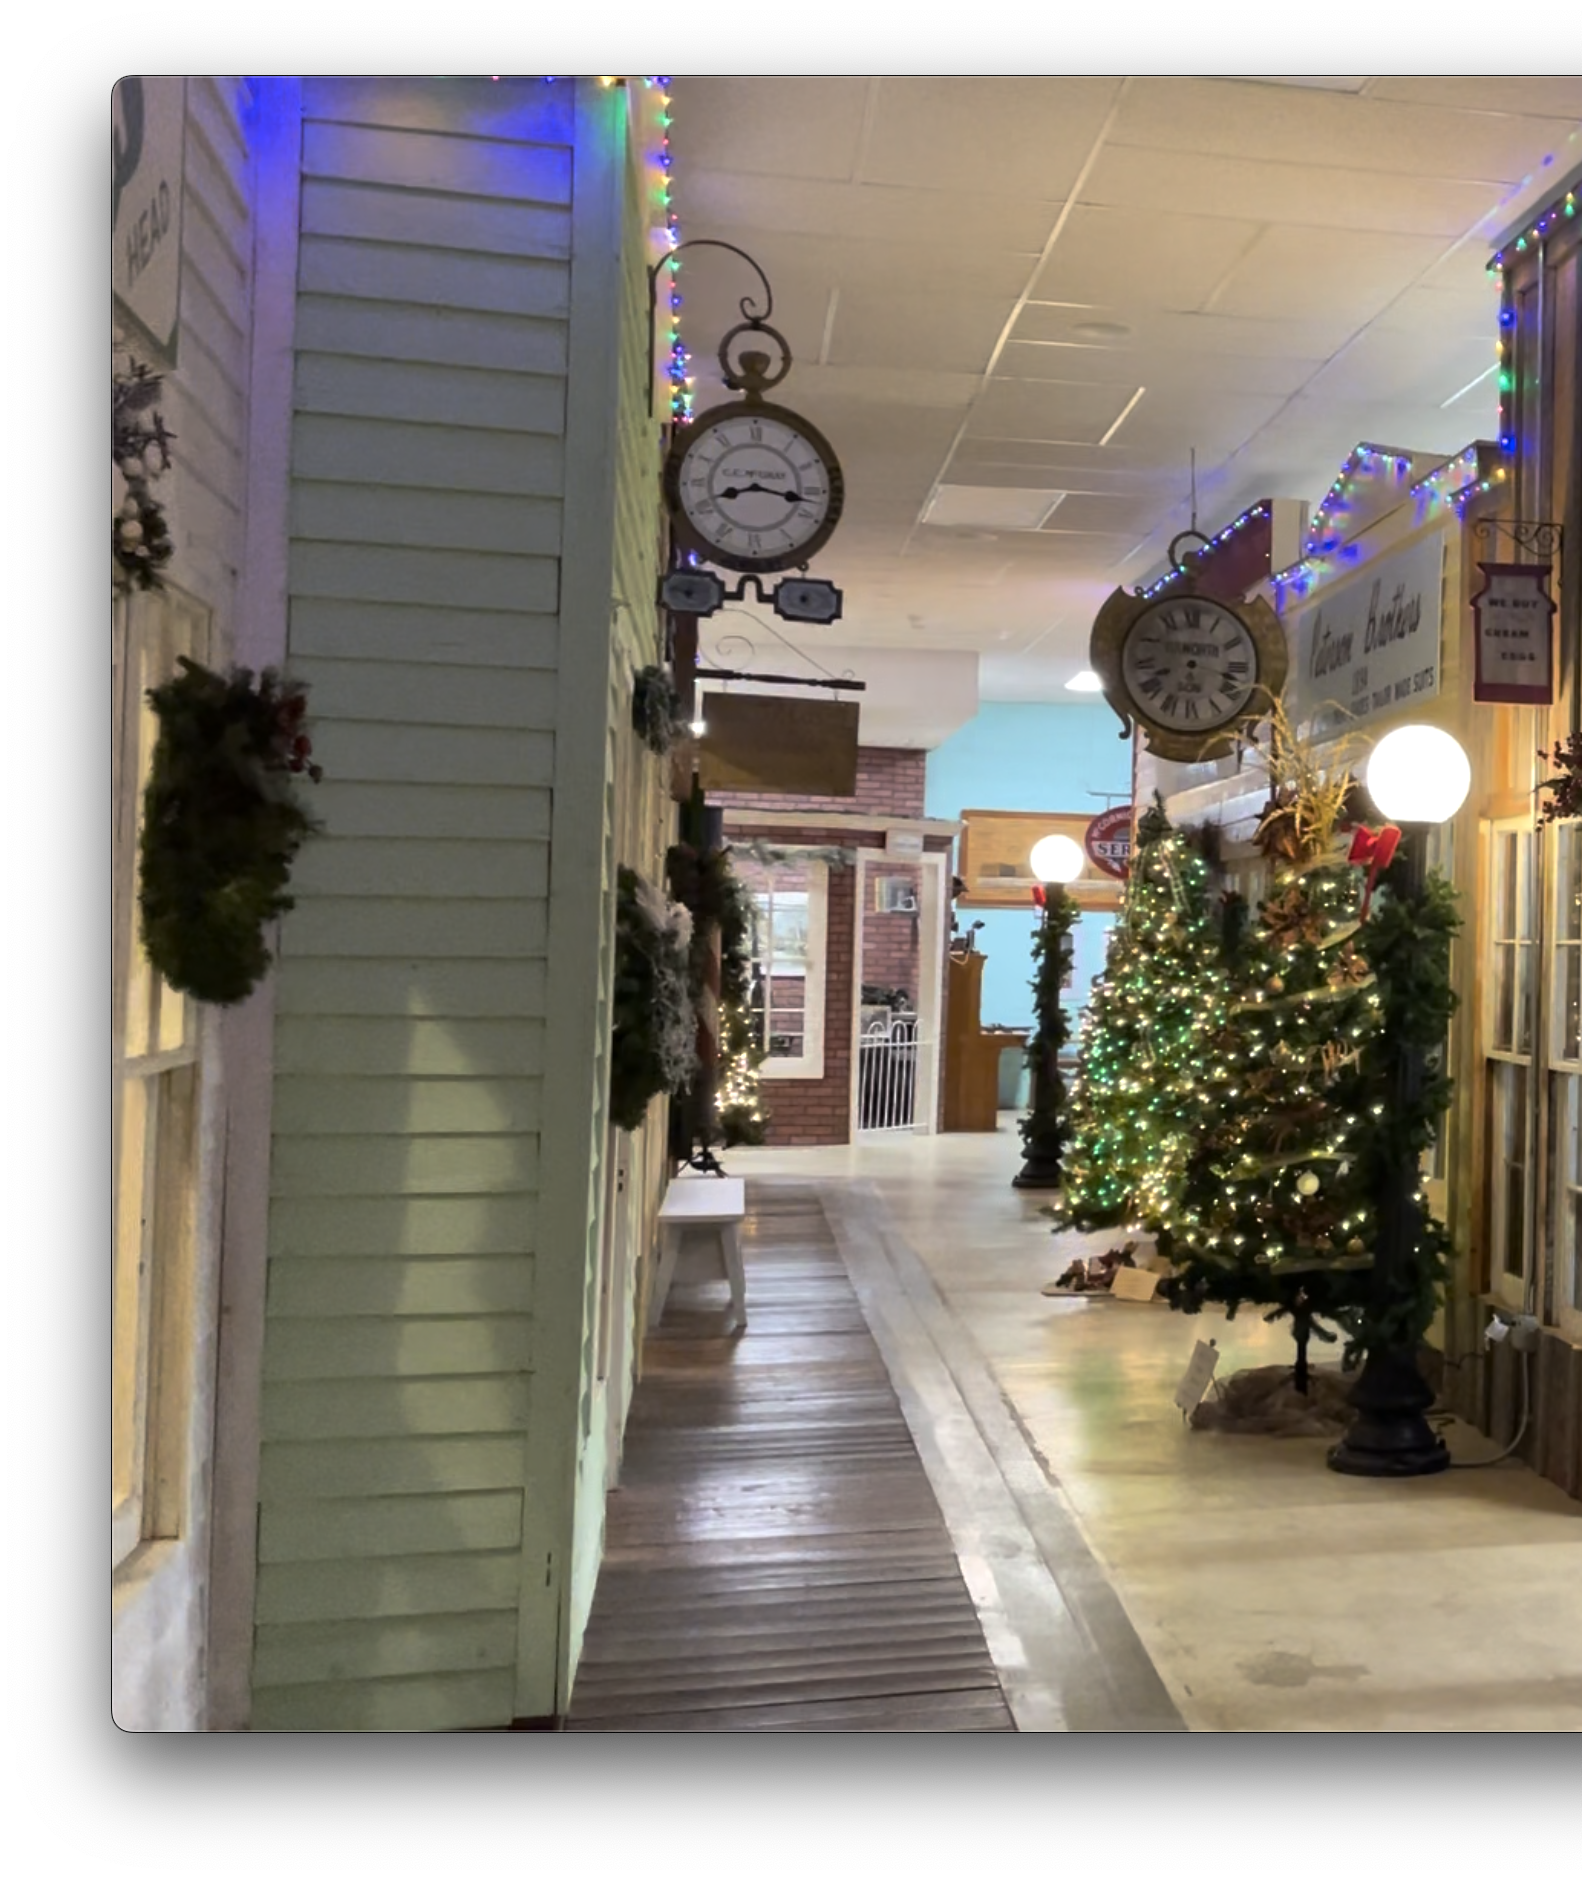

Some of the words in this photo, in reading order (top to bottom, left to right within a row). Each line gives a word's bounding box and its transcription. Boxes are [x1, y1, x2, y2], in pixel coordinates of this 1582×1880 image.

[127, 179, 170, 288] HEAD
[1488, 599, 1507, 608] WE
[1512, 600, 1538, 609] BUY
[1485, 629, 1529, 638] CREAM
[1501, 652, 1535, 661] EGGS
[1413, 666, 1434, 692] SUITS
